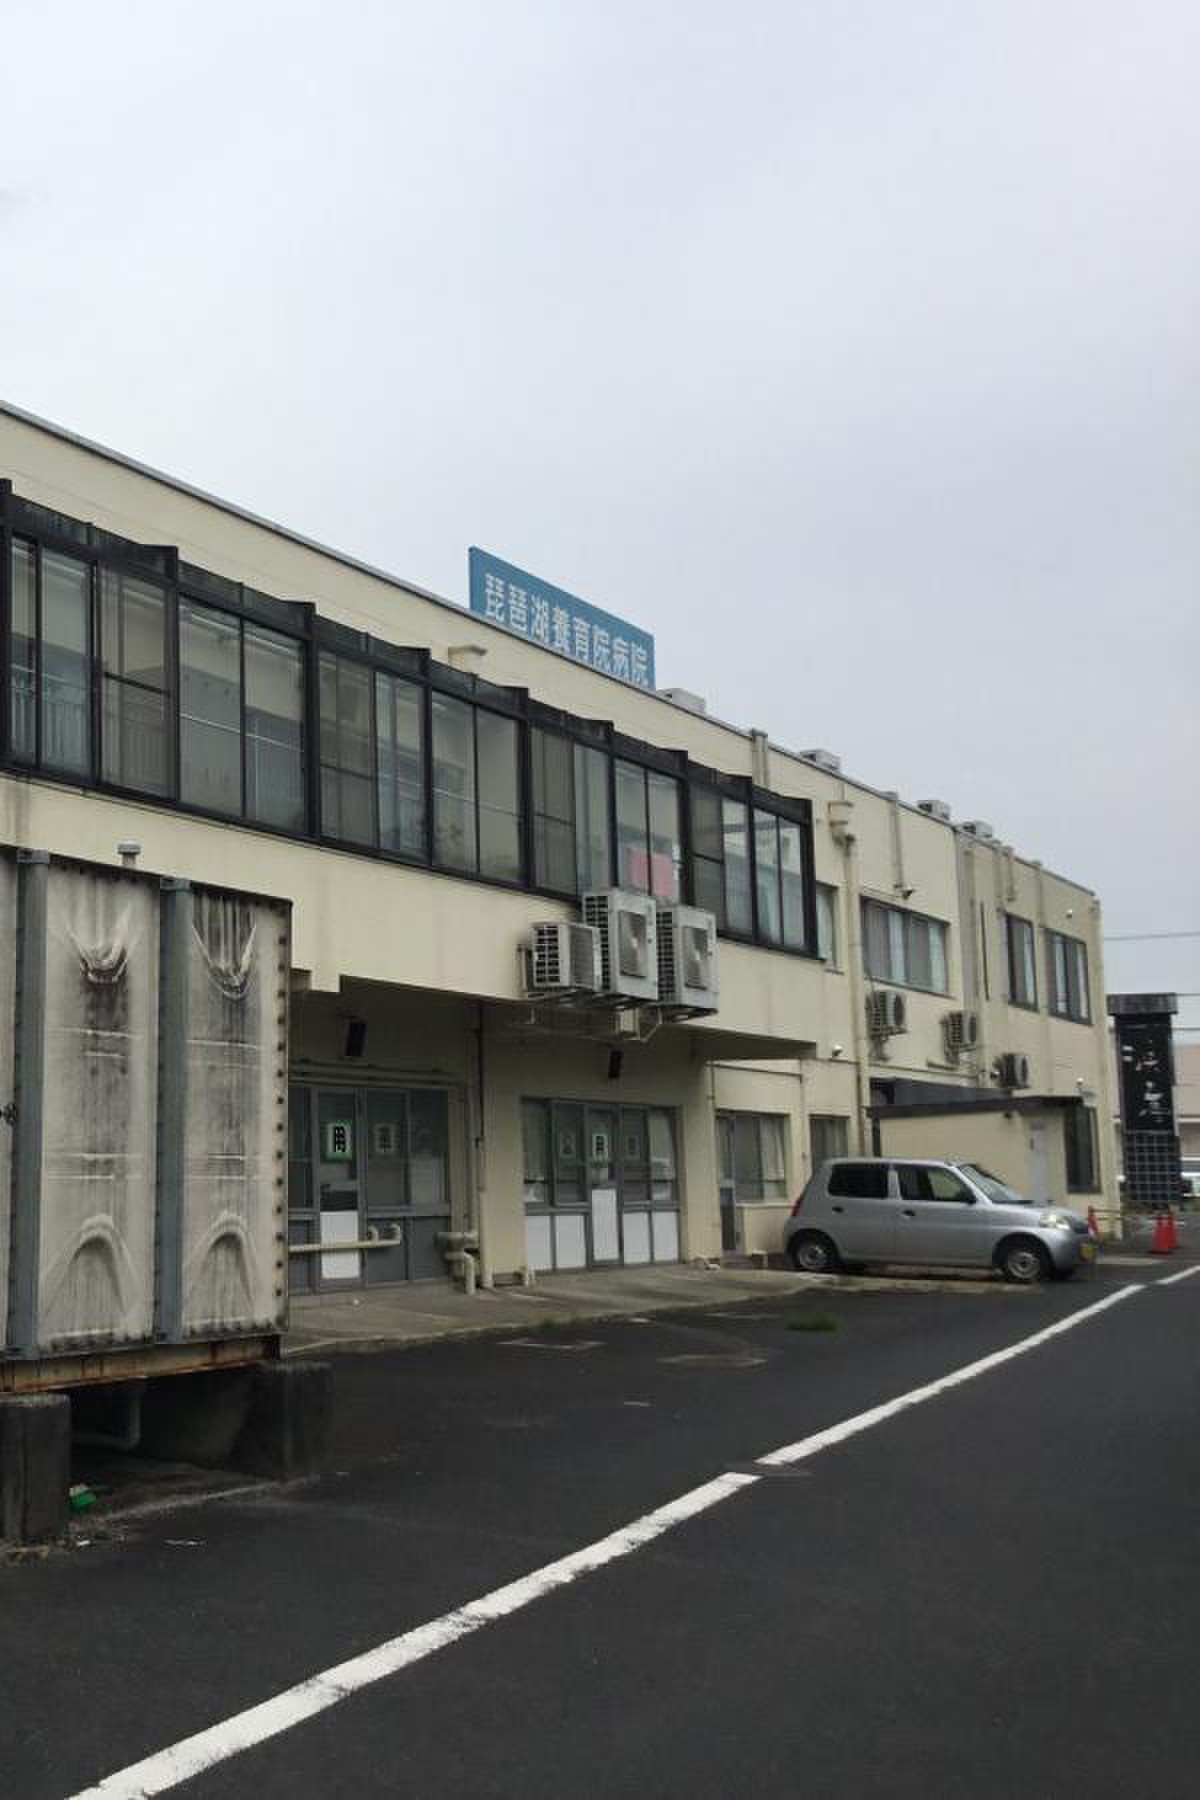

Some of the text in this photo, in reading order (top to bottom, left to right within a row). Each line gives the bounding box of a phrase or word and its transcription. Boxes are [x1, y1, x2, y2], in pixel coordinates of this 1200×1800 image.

[484, 573, 649, 686] 琵琶湖養育院病院
